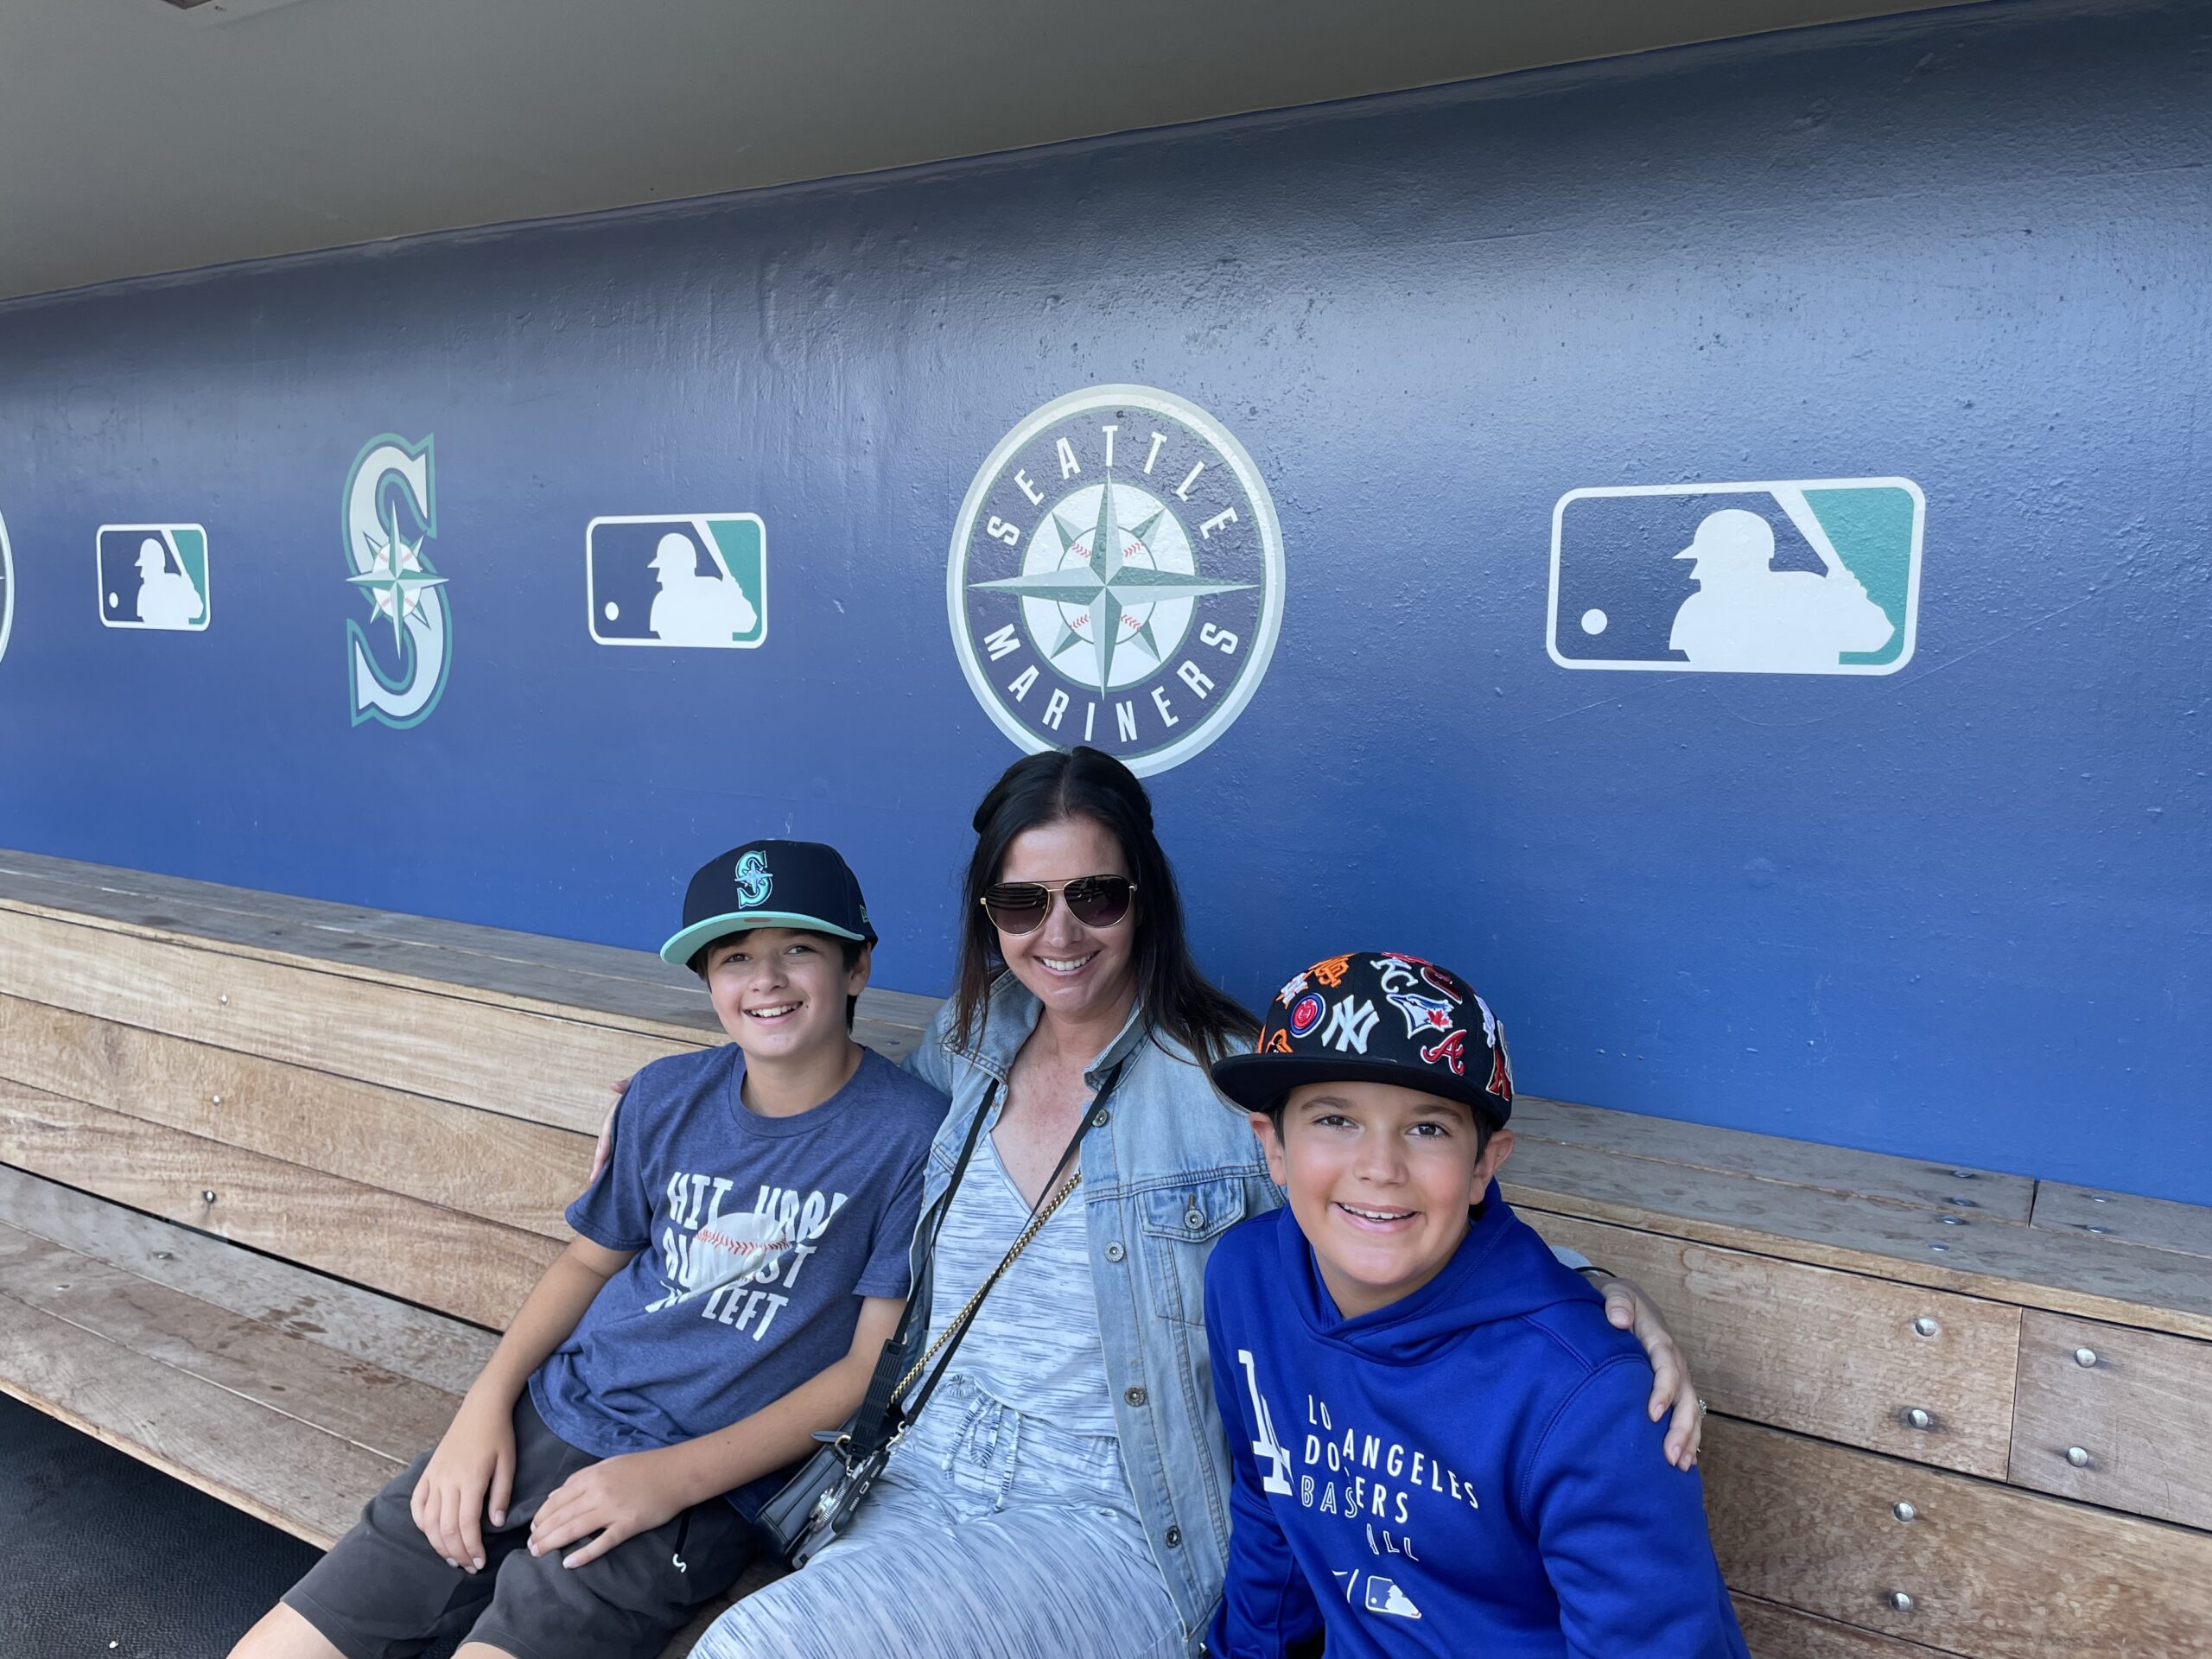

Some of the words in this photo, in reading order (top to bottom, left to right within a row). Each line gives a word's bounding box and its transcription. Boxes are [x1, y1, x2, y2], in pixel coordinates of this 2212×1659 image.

[986, 424, 1239, 546] SEATTLE
[341, 432, 453, 730] S
[983, 621, 1239, 742] MARINERS
[734, 850, 773, 909] S
[1320, 994, 1381, 1055] NY
[1420, 1028, 1467, 1077] A
[666, 1171, 734, 1233] HIT
[701, 1286, 790, 1342] LEFT
[1304, 1433, 1409, 1524] DOERS
[1307, 1394, 1332, 1431] LO
[1342, 1427, 1479, 1510] ANGELES
[1300, 1474, 1420, 1562] BASALL
